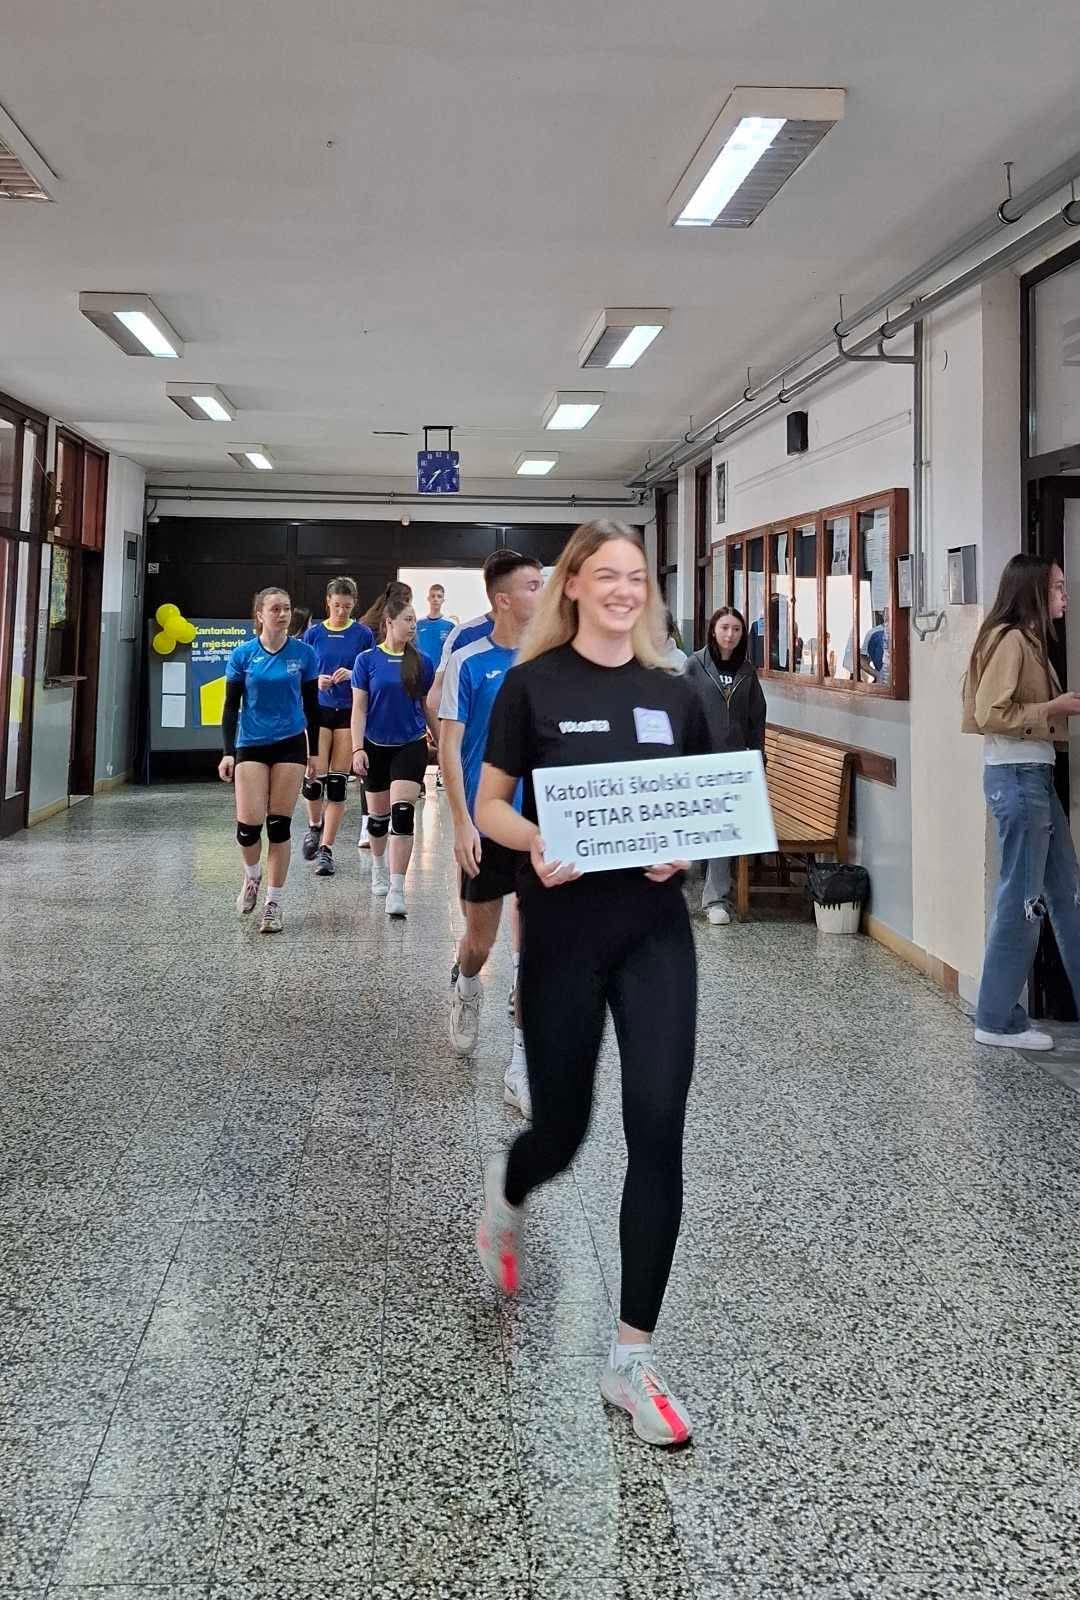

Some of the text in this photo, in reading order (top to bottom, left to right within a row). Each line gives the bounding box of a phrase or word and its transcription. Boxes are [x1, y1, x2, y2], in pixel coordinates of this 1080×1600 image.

[545, 770, 754, 802] Katolički školski centar
[564, 792, 741, 828] "PETAR BARBARIĆ"
[576, 823, 742, 857] Gimnazija Travnik
